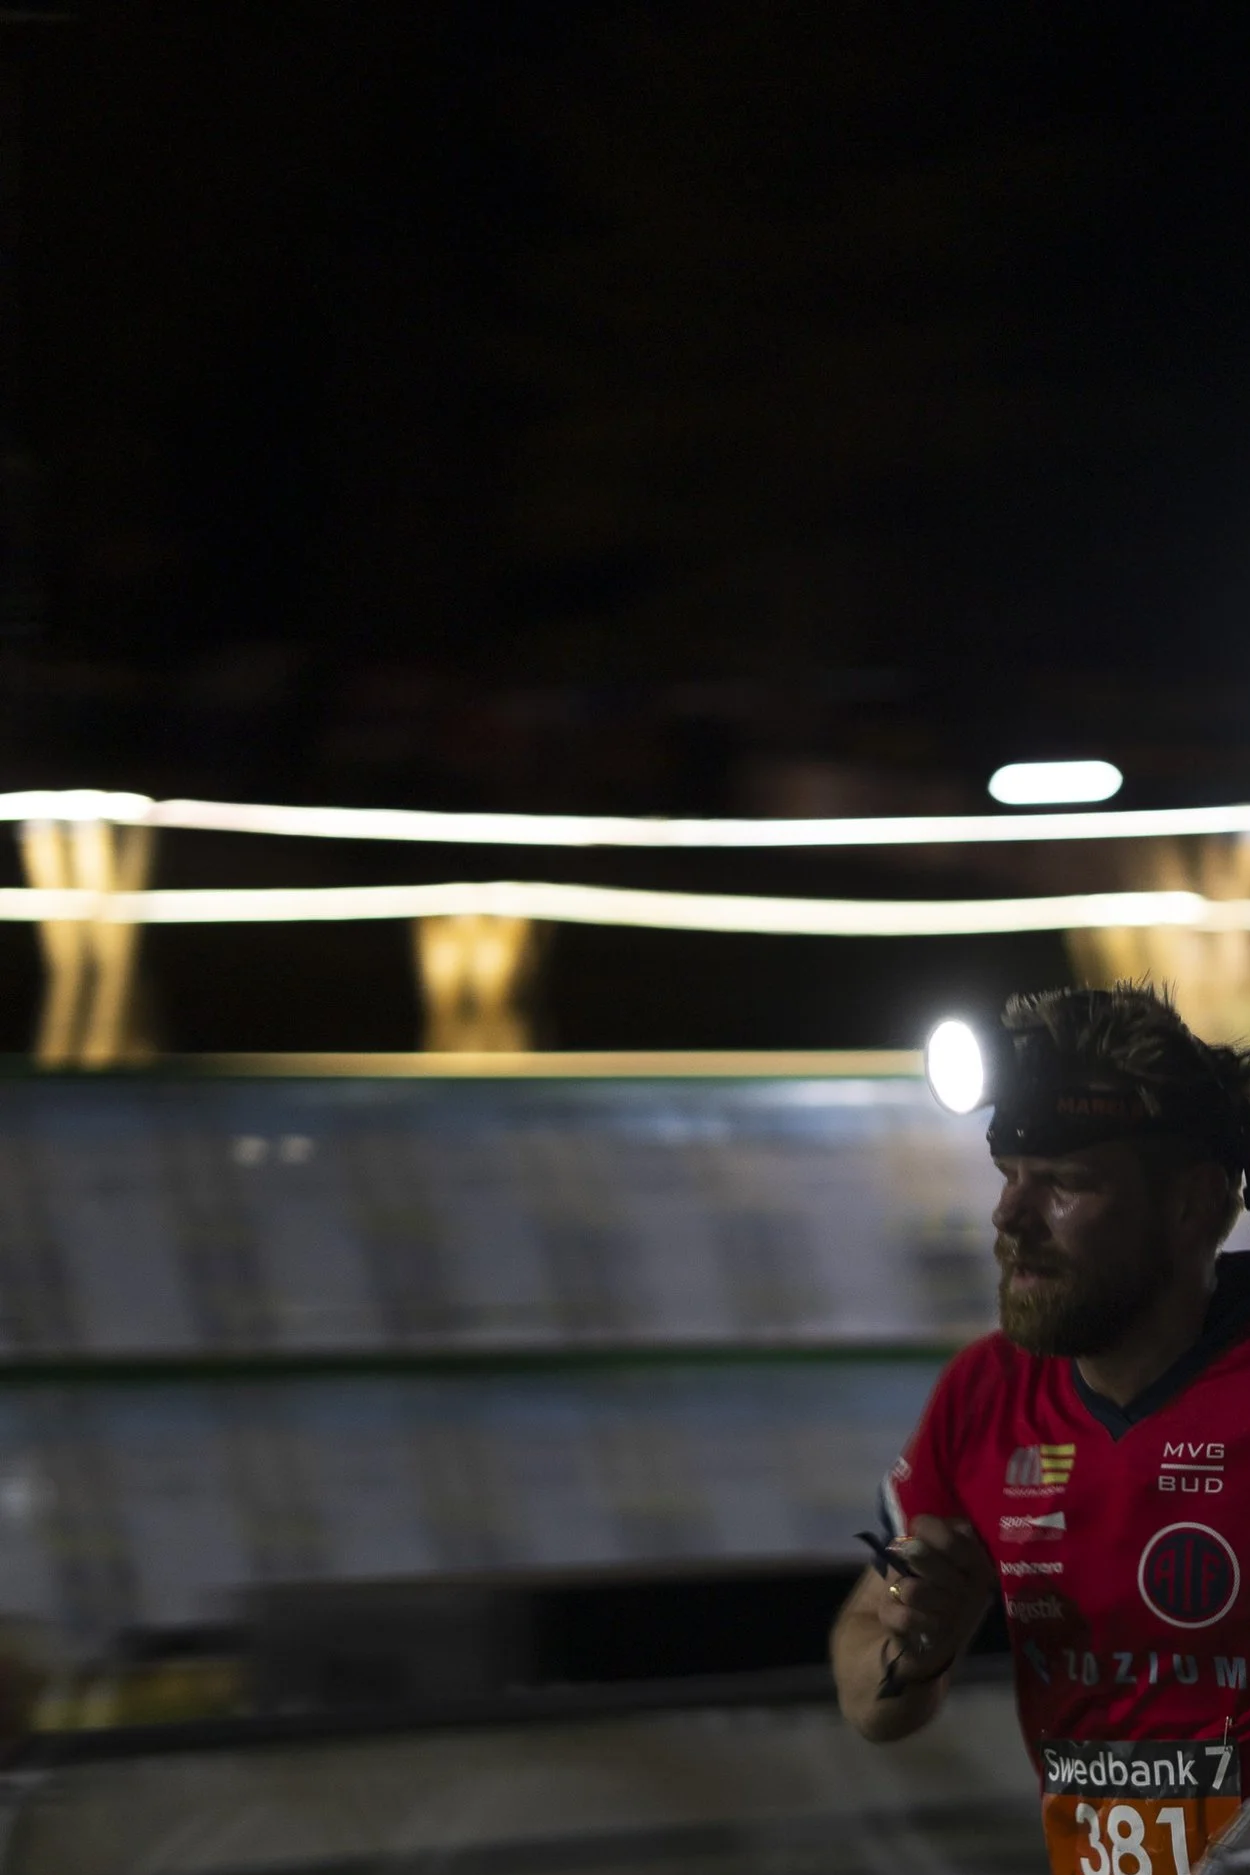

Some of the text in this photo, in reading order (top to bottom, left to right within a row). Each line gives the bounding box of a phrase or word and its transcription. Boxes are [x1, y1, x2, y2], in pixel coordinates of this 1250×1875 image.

[1163, 1442, 1225, 1459] MVG
[1157, 1475, 1224, 1494] BUD
[1044, 1745, 1234, 1790] Swedbank 7
